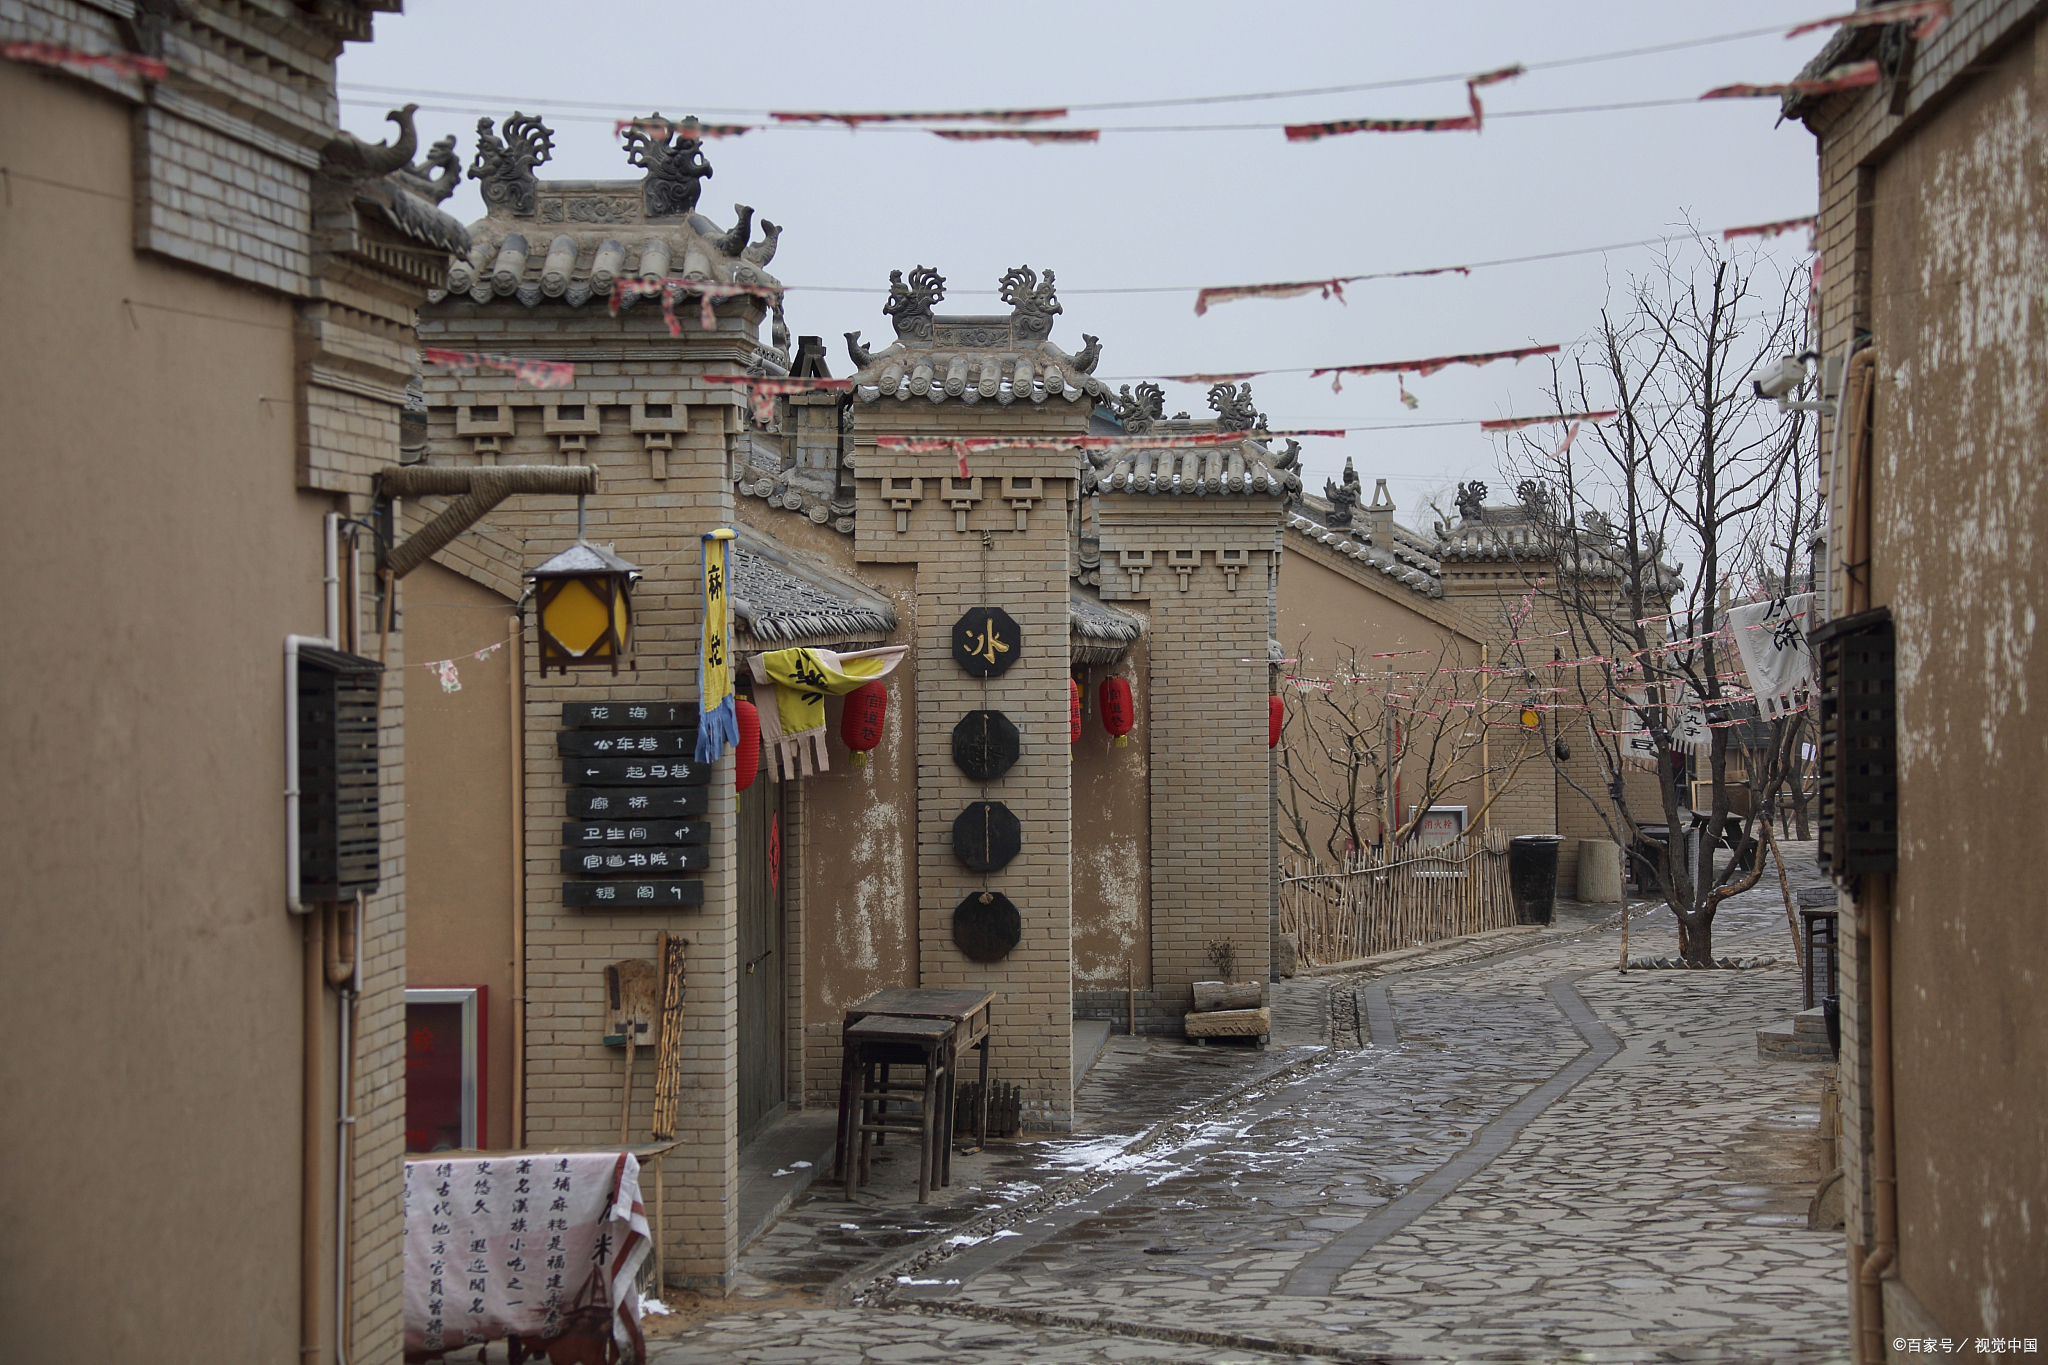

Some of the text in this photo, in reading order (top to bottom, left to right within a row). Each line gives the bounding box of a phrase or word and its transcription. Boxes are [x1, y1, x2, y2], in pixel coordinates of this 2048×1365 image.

[963, 617, 1010, 664] 冰
[590, 707, 648, 720] 花海
[861, 693, 882, 741] 官道巷
[594, 737, 659, 750] 公车巷
[625, 764, 691, 779] 起马巷
[590, 797, 649, 810] 廊桥
[1424, 819, 1453, 830] 消火栓
[583, 828, 648, 840] 卫生间
[583, 853, 669, 870] 官道书院
[411, 1027, 435, 1051] 栓
